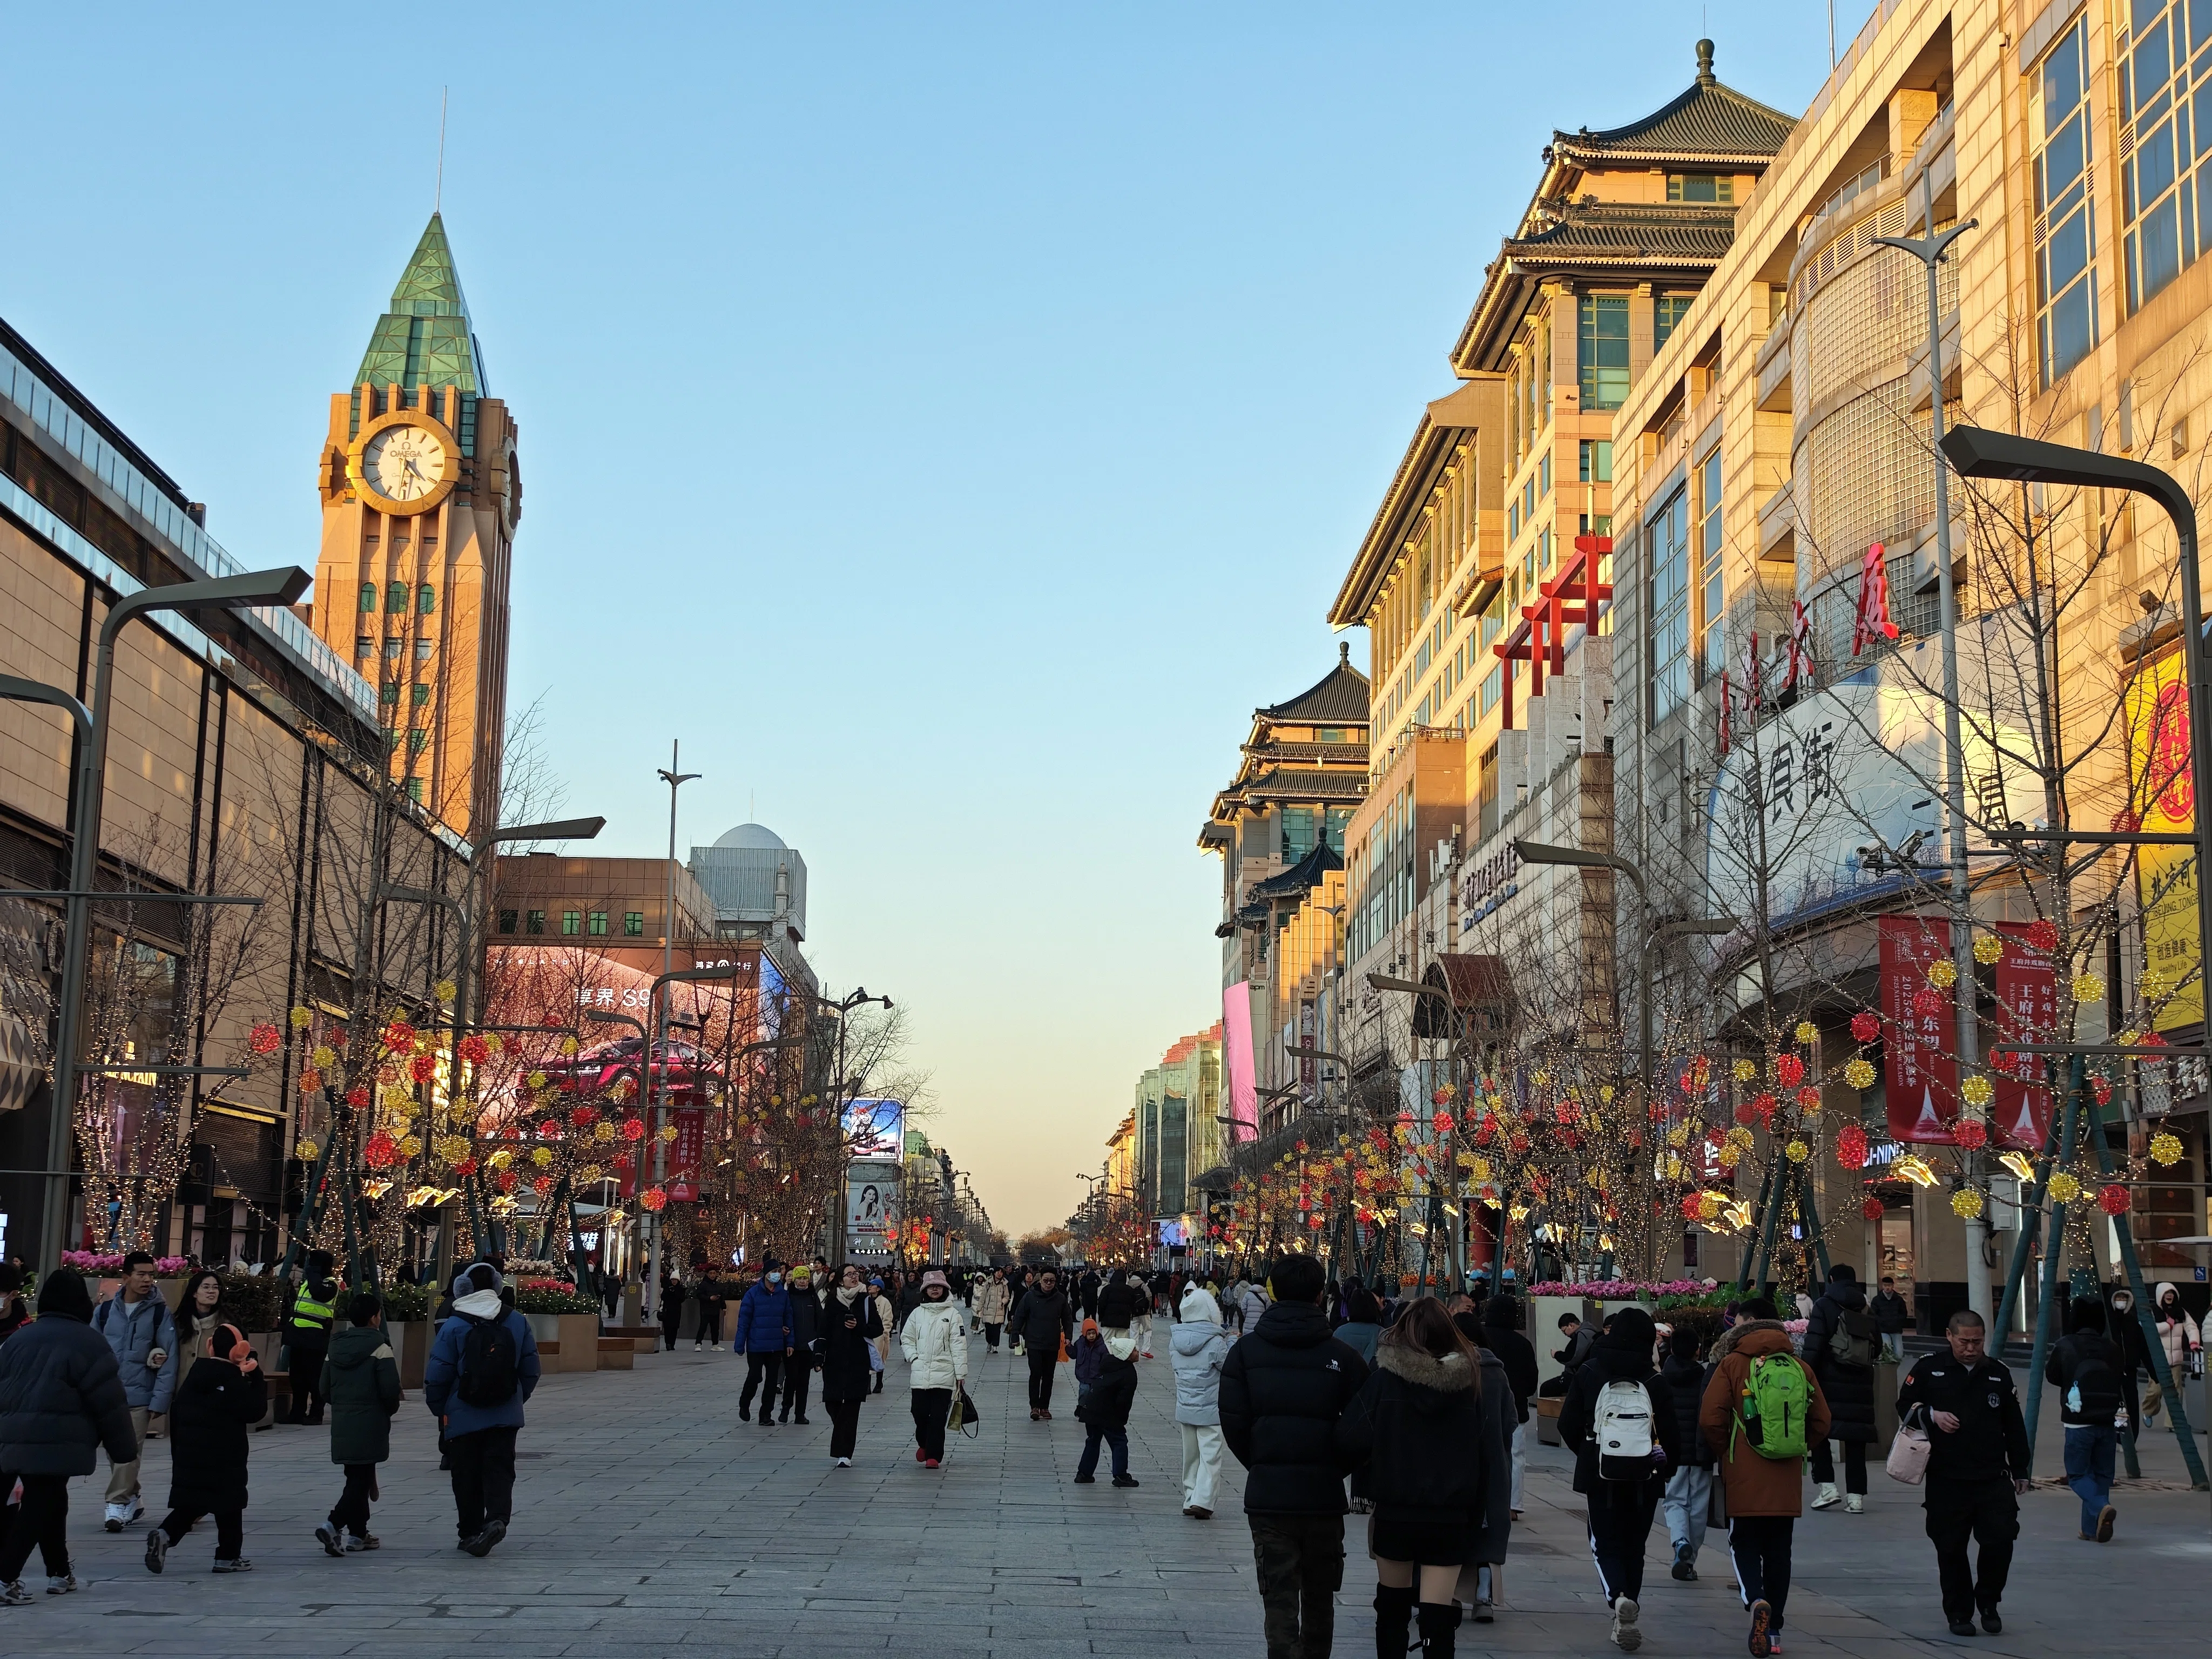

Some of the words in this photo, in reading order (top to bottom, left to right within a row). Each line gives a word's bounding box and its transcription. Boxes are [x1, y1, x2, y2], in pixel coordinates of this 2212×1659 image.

[2151, 858, 2196, 901] 北京同
[2159, 962, 2176, 974] Healthy
[2177, 960, 2187, 970] Life
